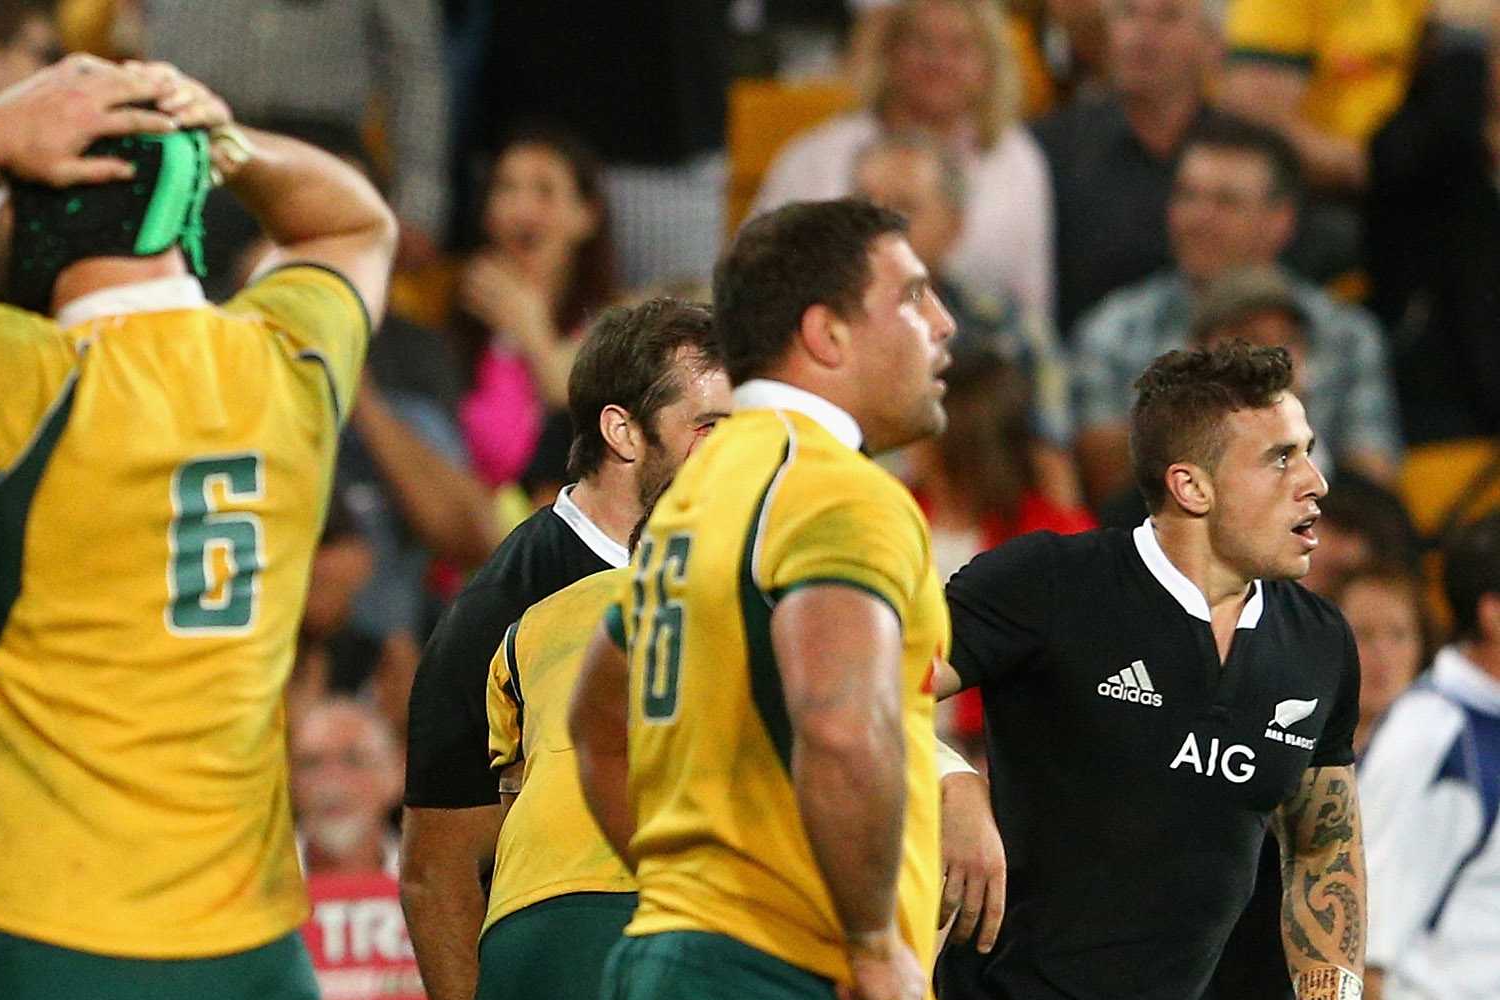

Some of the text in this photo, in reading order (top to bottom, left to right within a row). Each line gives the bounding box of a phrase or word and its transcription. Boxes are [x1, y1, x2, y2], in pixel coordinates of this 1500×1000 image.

[164, 453, 266, 638] 6
[1097, 682, 1163, 707] adidas
[1169, 732, 1256, 783] AIG
[316, 900, 415, 960] TR
